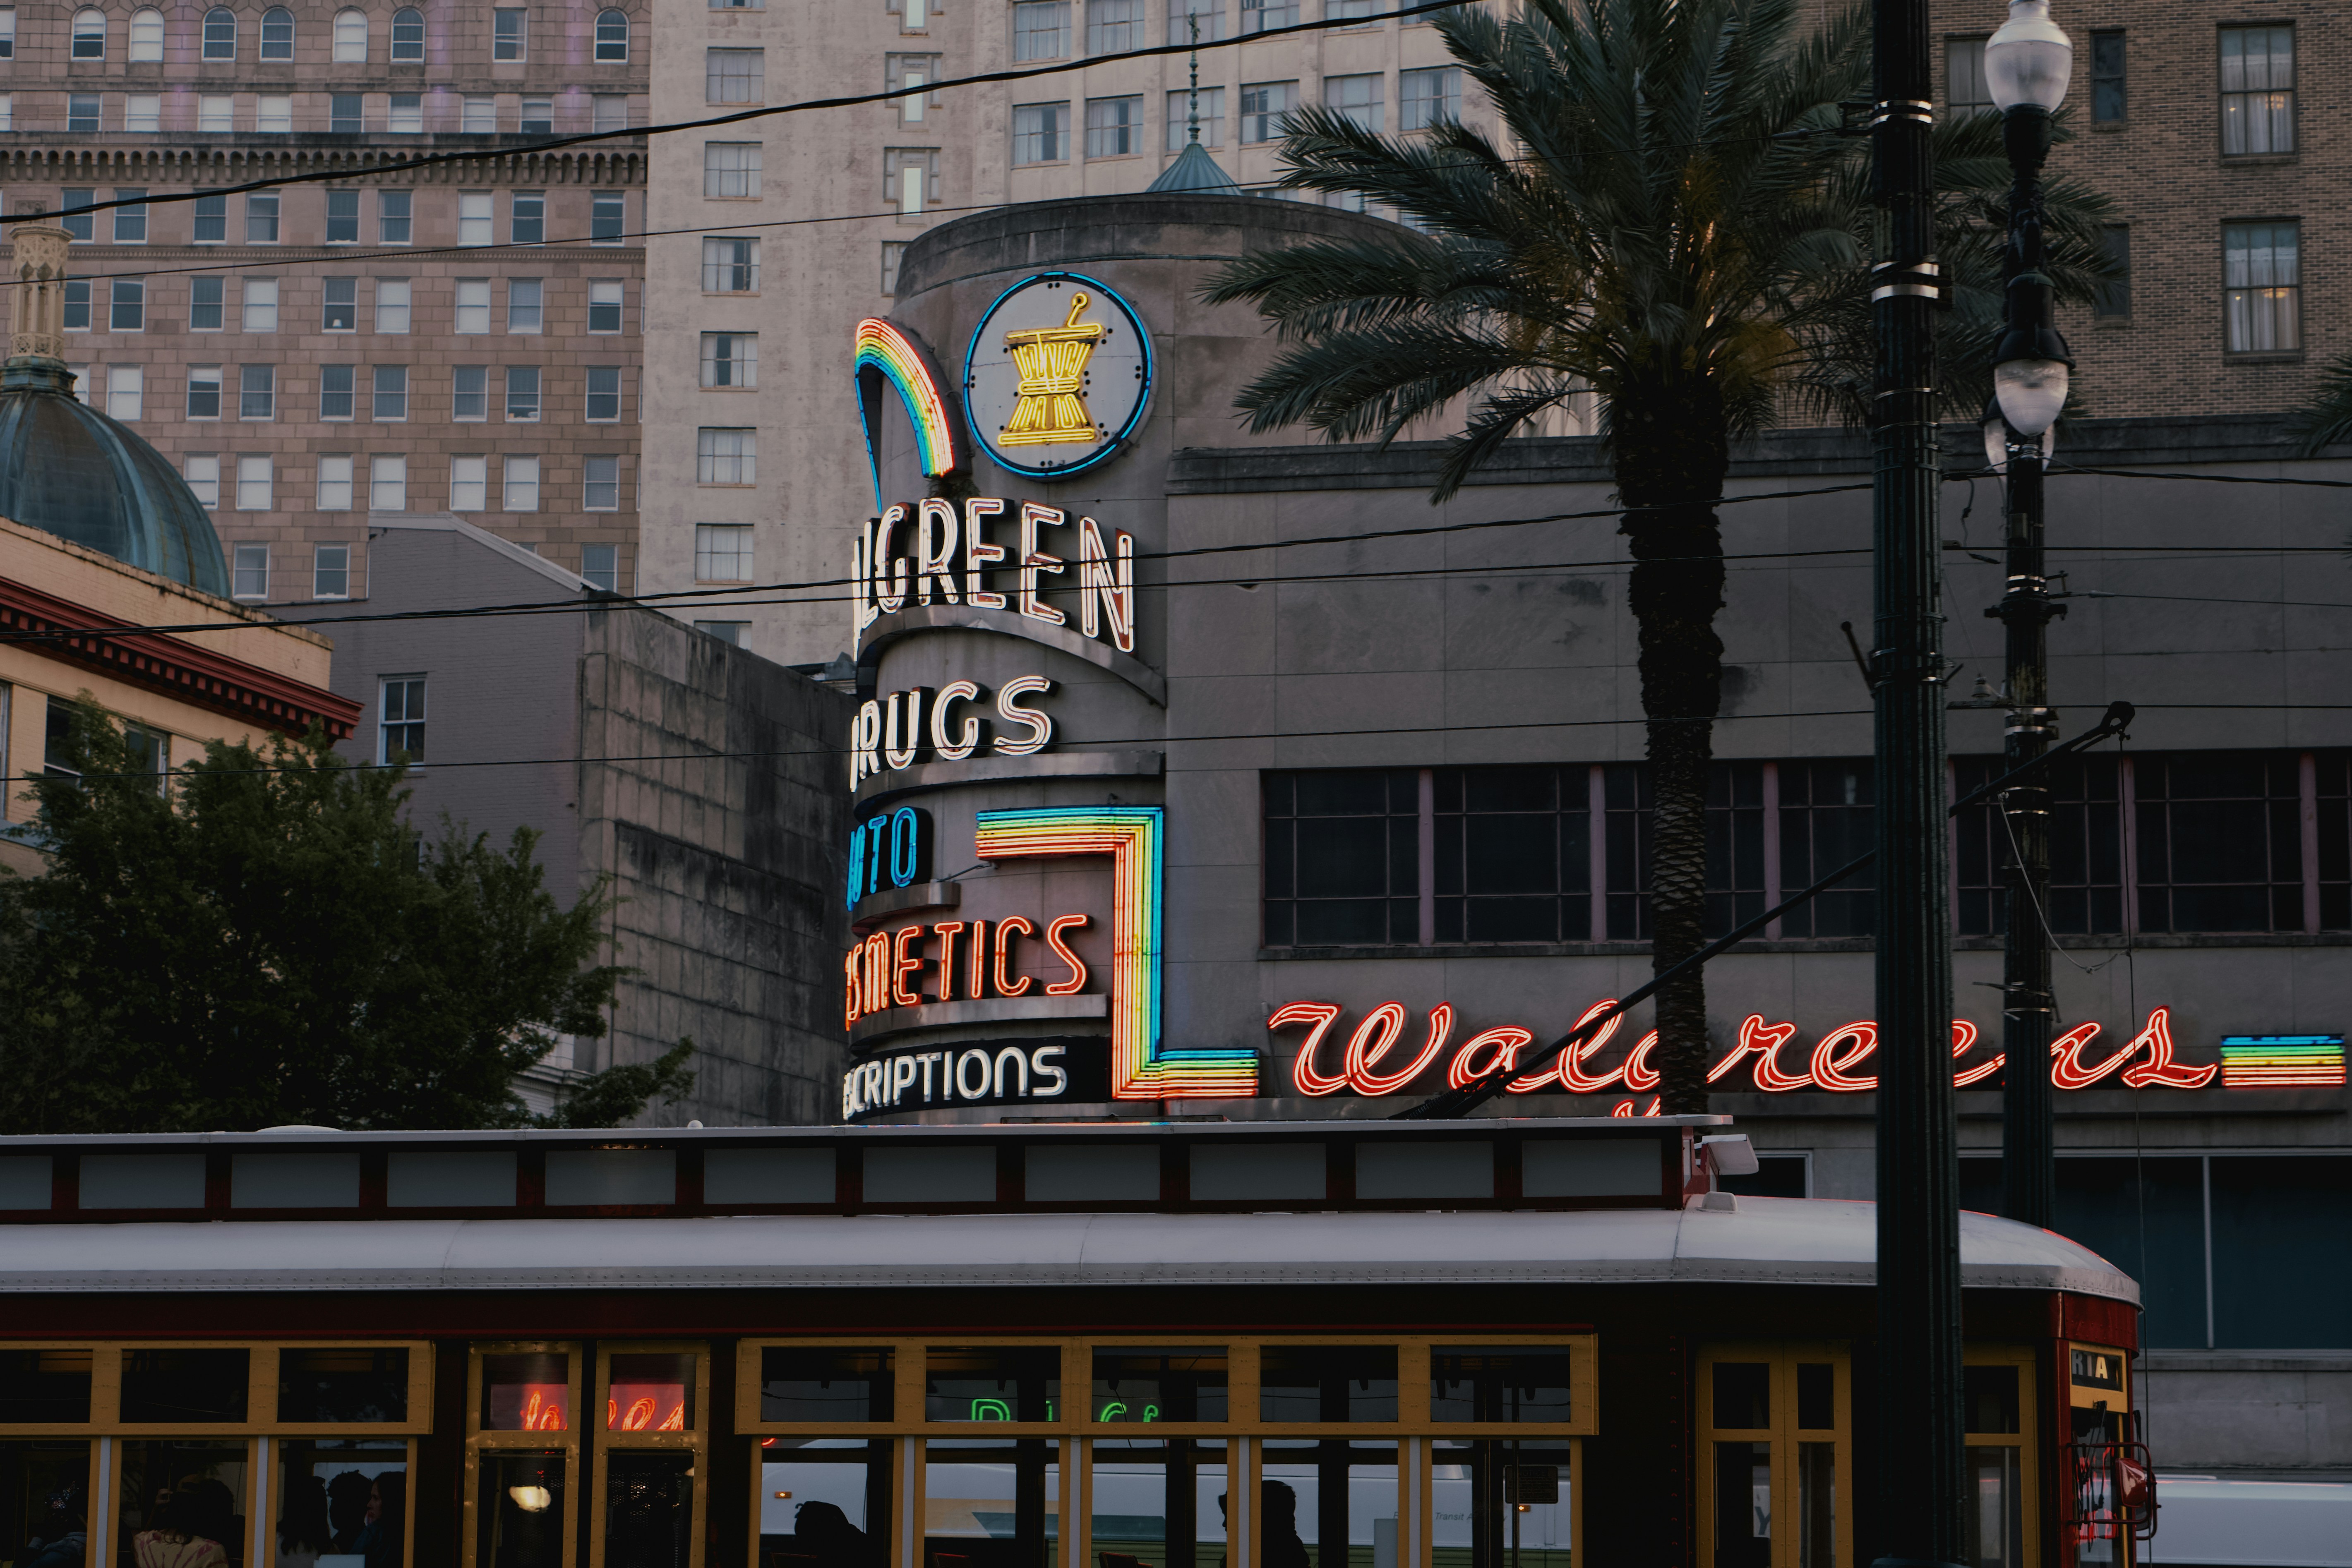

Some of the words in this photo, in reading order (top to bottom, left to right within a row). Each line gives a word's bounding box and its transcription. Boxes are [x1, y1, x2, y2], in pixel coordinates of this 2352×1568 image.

[850, 675, 1052, 792] RUGS
[1267, 998, 2218, 1117] Walres
[1435, 1512, 1464, 1520] Transit
